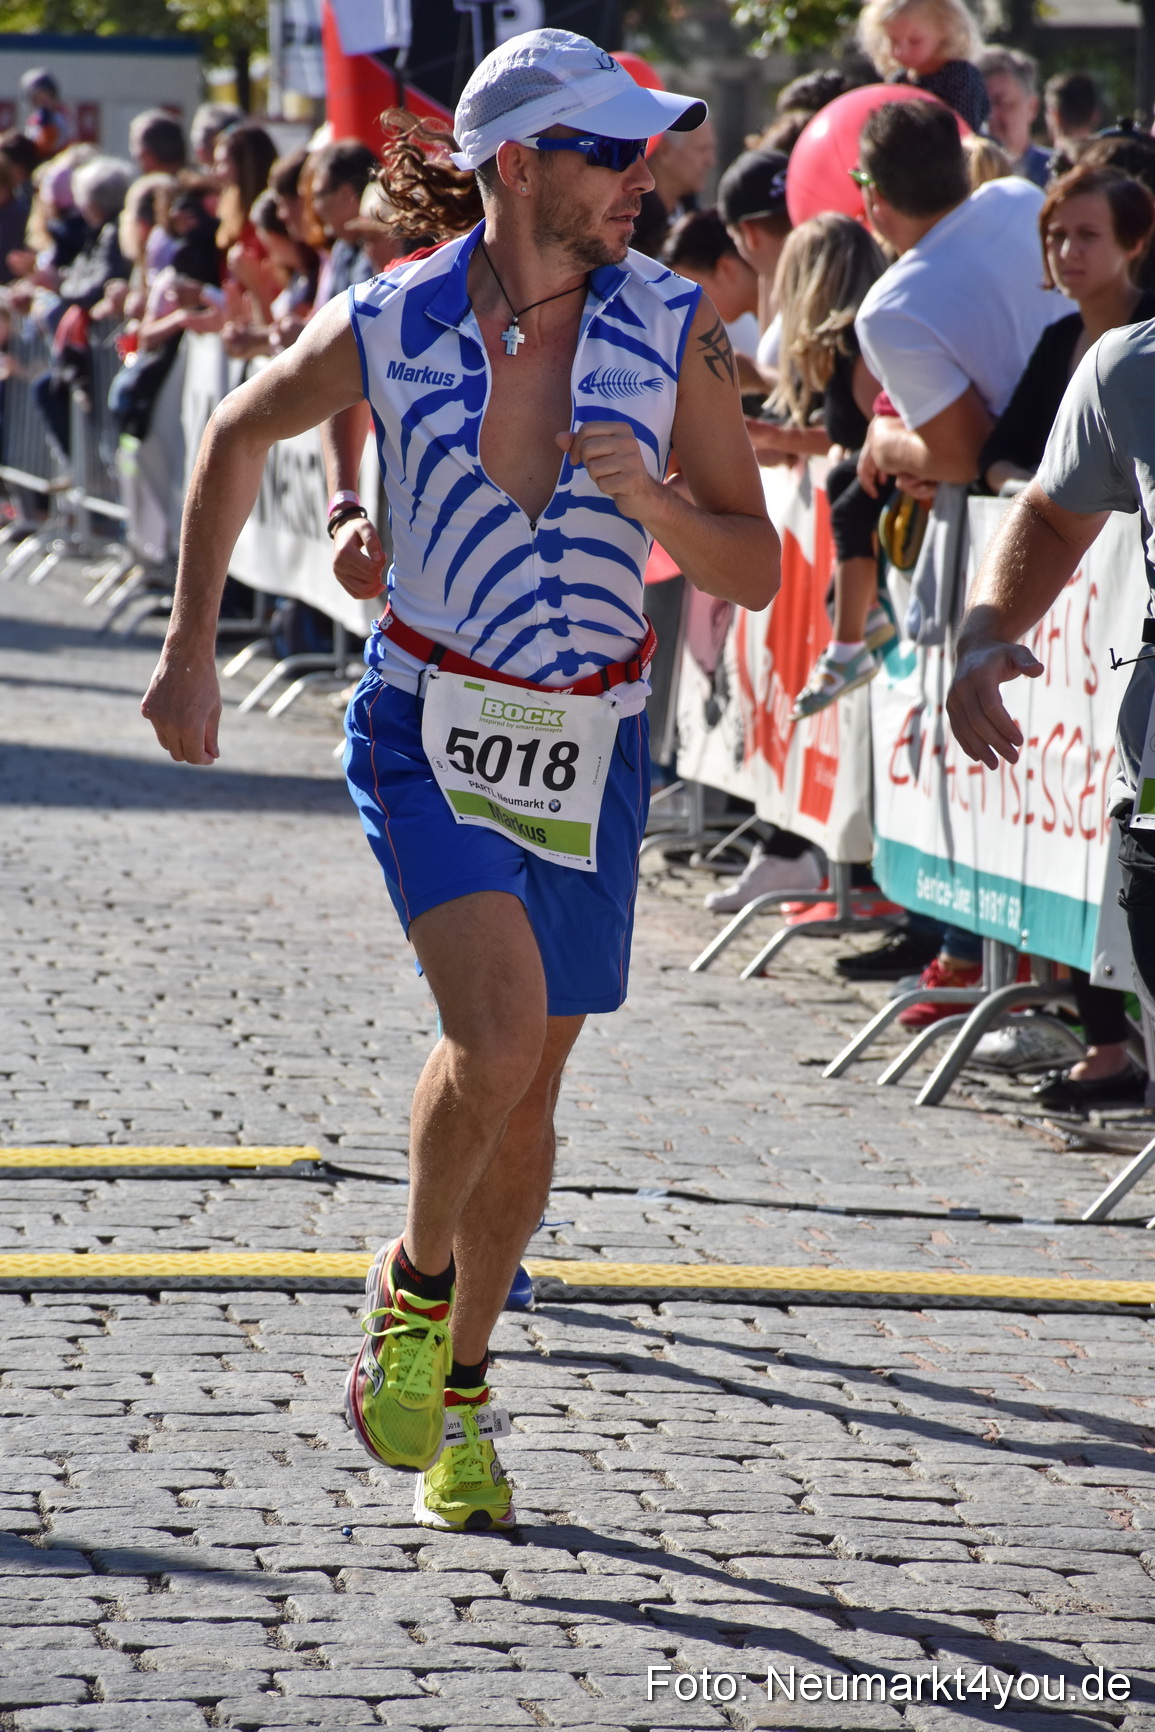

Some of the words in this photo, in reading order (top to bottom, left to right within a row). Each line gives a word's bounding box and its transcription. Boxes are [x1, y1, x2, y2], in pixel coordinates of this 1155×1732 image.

[386, 360, 456, 387] Markus
[479, 716, 506, 727] inspired
[507, 721, 514, 729] by
[481, 697, 567, 727] BOCK
[445, 727, 580, 792] 5018
[468, 780, 498, 798] PARTL
[497, 791, 545, 810] Neumarkt
[487, 801, 547, 844] Markus
